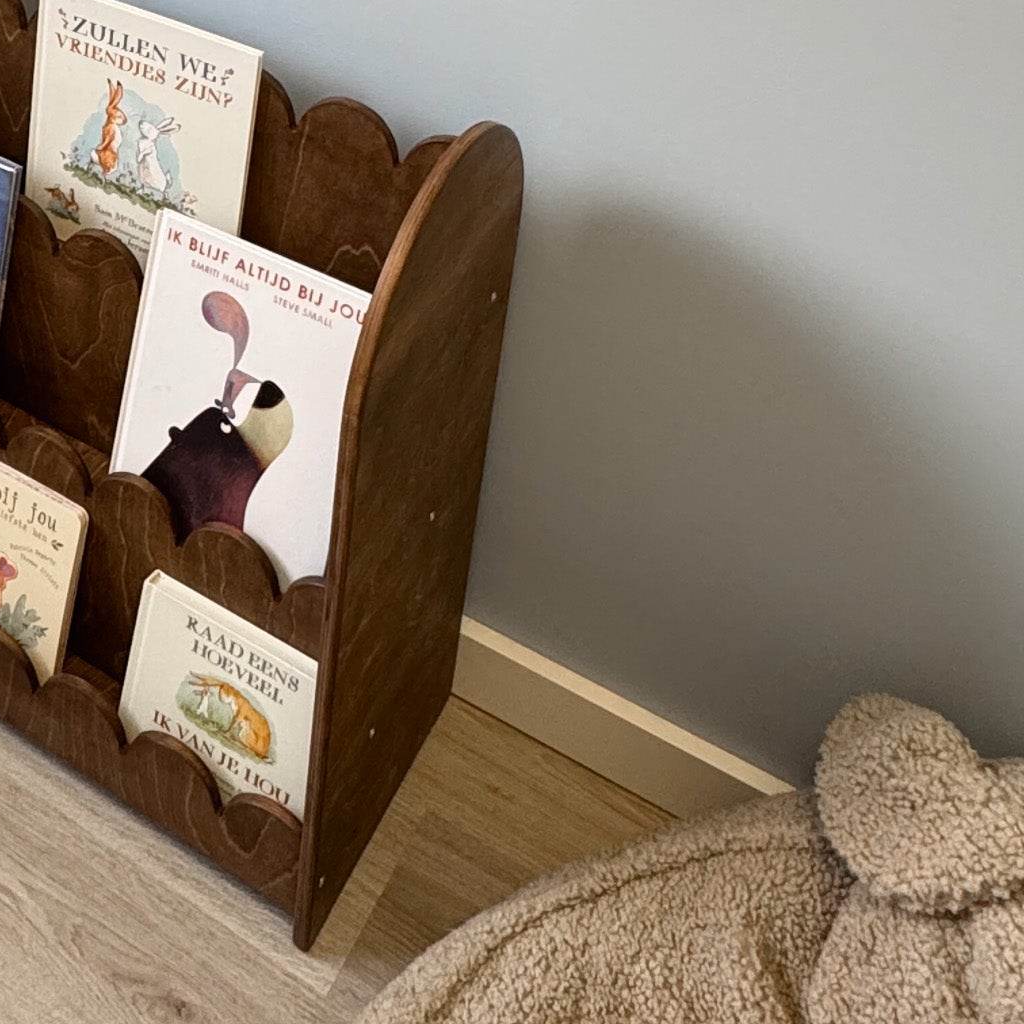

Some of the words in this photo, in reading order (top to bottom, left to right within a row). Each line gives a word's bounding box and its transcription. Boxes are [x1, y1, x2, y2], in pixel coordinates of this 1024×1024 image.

[55, 32, 166, 85] VRIENDJES
[175, 75, 233, 108] ZIJN?
[72, 16, 169, 64] ZULLEN
[167, 227, 182, 245] IK
[189, 237, 230, 264] BLIJF
[235, 258, 291, 292] ALTIJD
[298, 284, 323, 307] BIJ
[329, 300, 367, 325] JOU
[191, 259, 219, 278] SMRITI
[223, 274, 249, 292] HALLS
[273, 295, 299, 313] STEVE
[302, 309, 333, 329] SMALL
[27, 502, 57, 532] jou
[186, 615, 244, 659] RAAD
[249, 653, 299, 692] EENS
[192, 639, 283, 705] HOEVEEL
[153, 709, 172, 733] IK
[177, 724, 215, 759] VAN
[218, 752, 239, 775] JE
[244, 766, 291, 805] HOU
